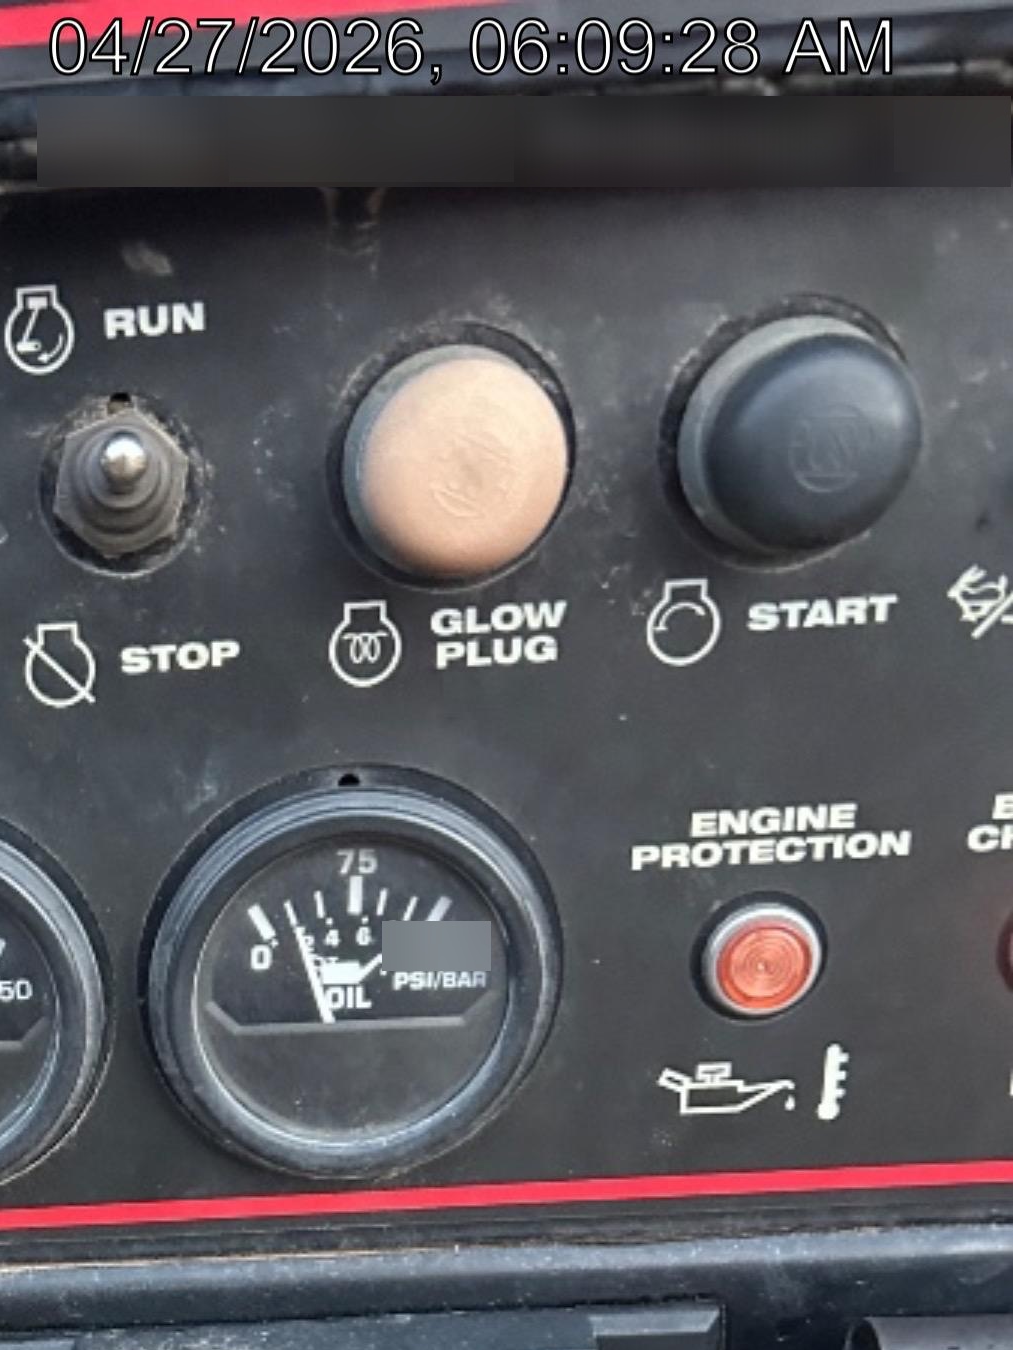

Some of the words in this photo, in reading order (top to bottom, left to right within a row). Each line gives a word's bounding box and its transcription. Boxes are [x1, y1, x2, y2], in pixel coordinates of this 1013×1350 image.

[104, 301, 206, 340] RUN
[430, 601, 566, 636] GLOW
[746, 593, 899, 631] START
[120, 640, 240, 674] STOP
[436, 635, 558, 669] PLUG
[690, 803, 857, 838] ENGINE
[336, 849, 378, 874] 75
[631, 831, 912, 870] PROTECTION
[323, 929, 340, 947] 4
[250, 945, 272, 970] 0
[393, 970, 486, 991] PSI/BAR
[325, 986, 373, 1010] OIL
